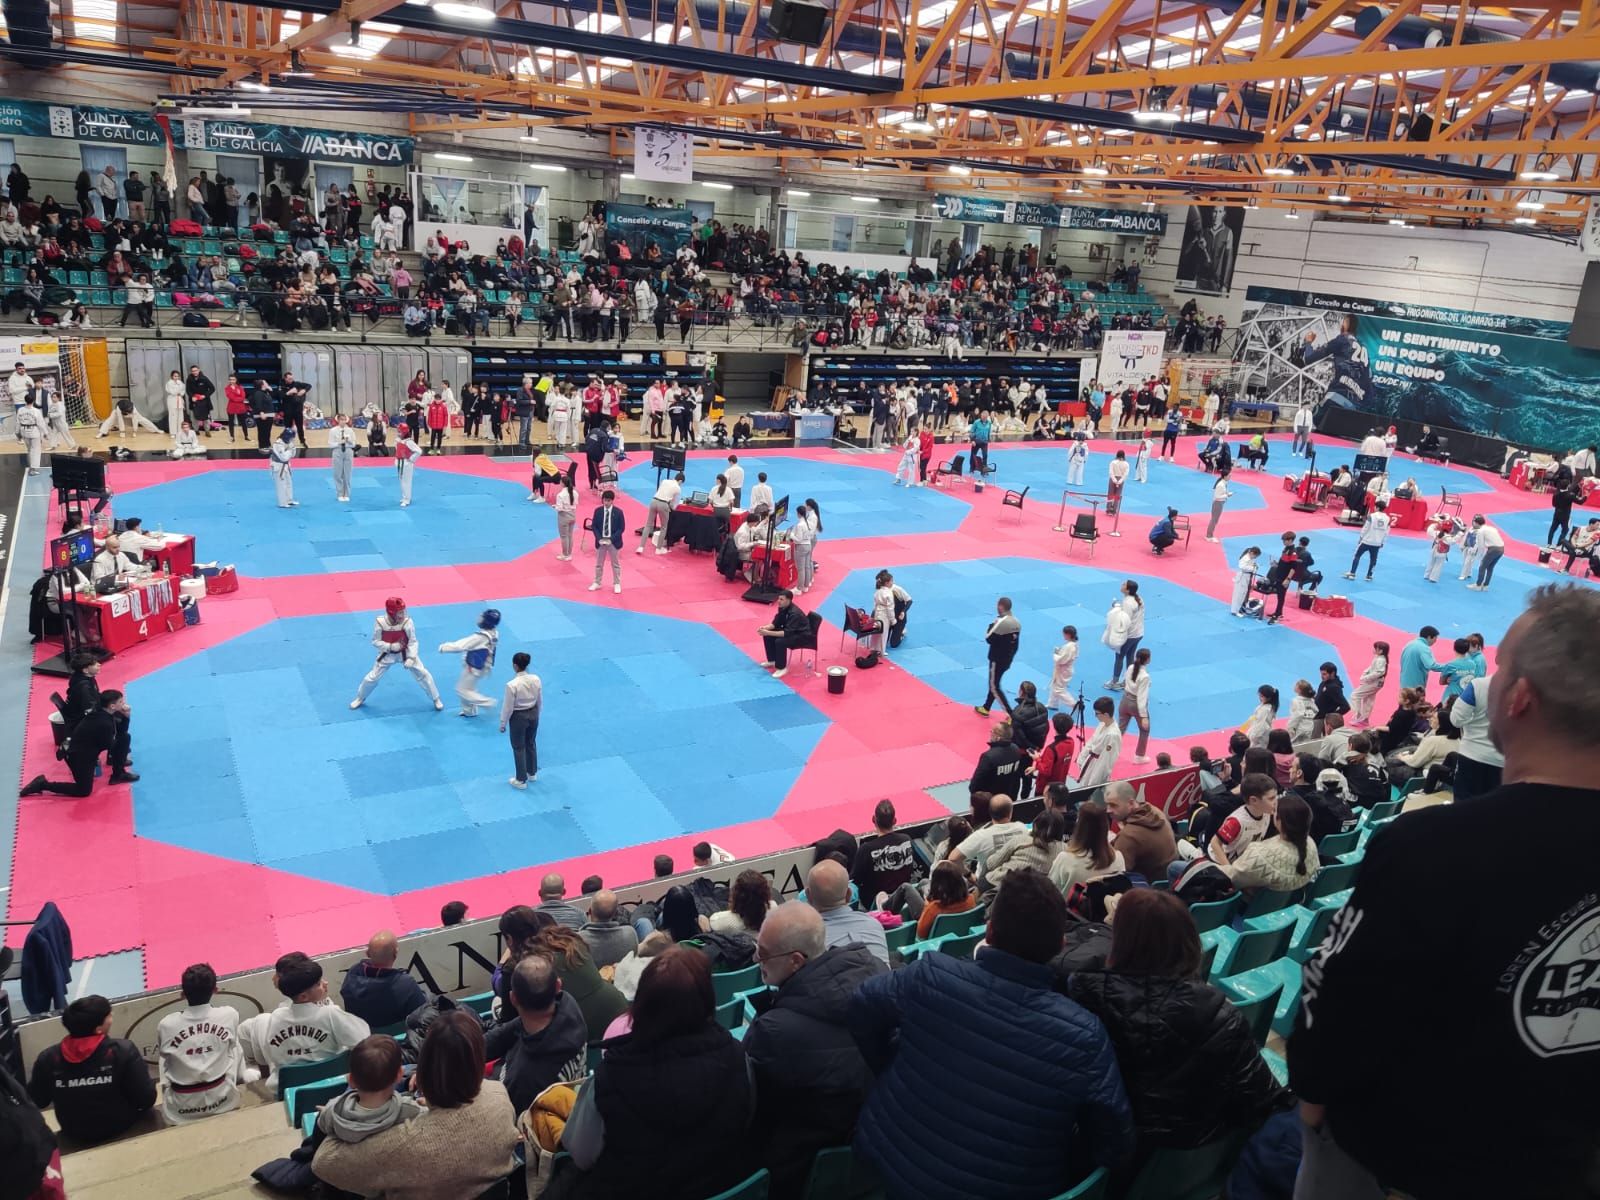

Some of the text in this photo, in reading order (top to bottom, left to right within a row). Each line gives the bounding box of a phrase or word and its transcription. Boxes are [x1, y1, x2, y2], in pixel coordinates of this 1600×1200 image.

[78, 111, 129, 126] XUNTA
[79, 125, 160, 142] DE GALICIA
[210, 124, 255, 138] XUNTA
[210, 137, 284, 153] DE GALICIA
[652, 217, 661, 226] de
[1016, 215, 1025, 223] DE
[1314, 298, 1375, 313] Concello de Cangas
[1381, 329, 1501, 357] UN SENTIMIENTO
[1378, 345, 1437, 364] UN POBO
[1375, 360, 1446, 382] UN EQUIPO
[138, 619, 148, 637] 4
[55, 1079, 65, 1088] R.
